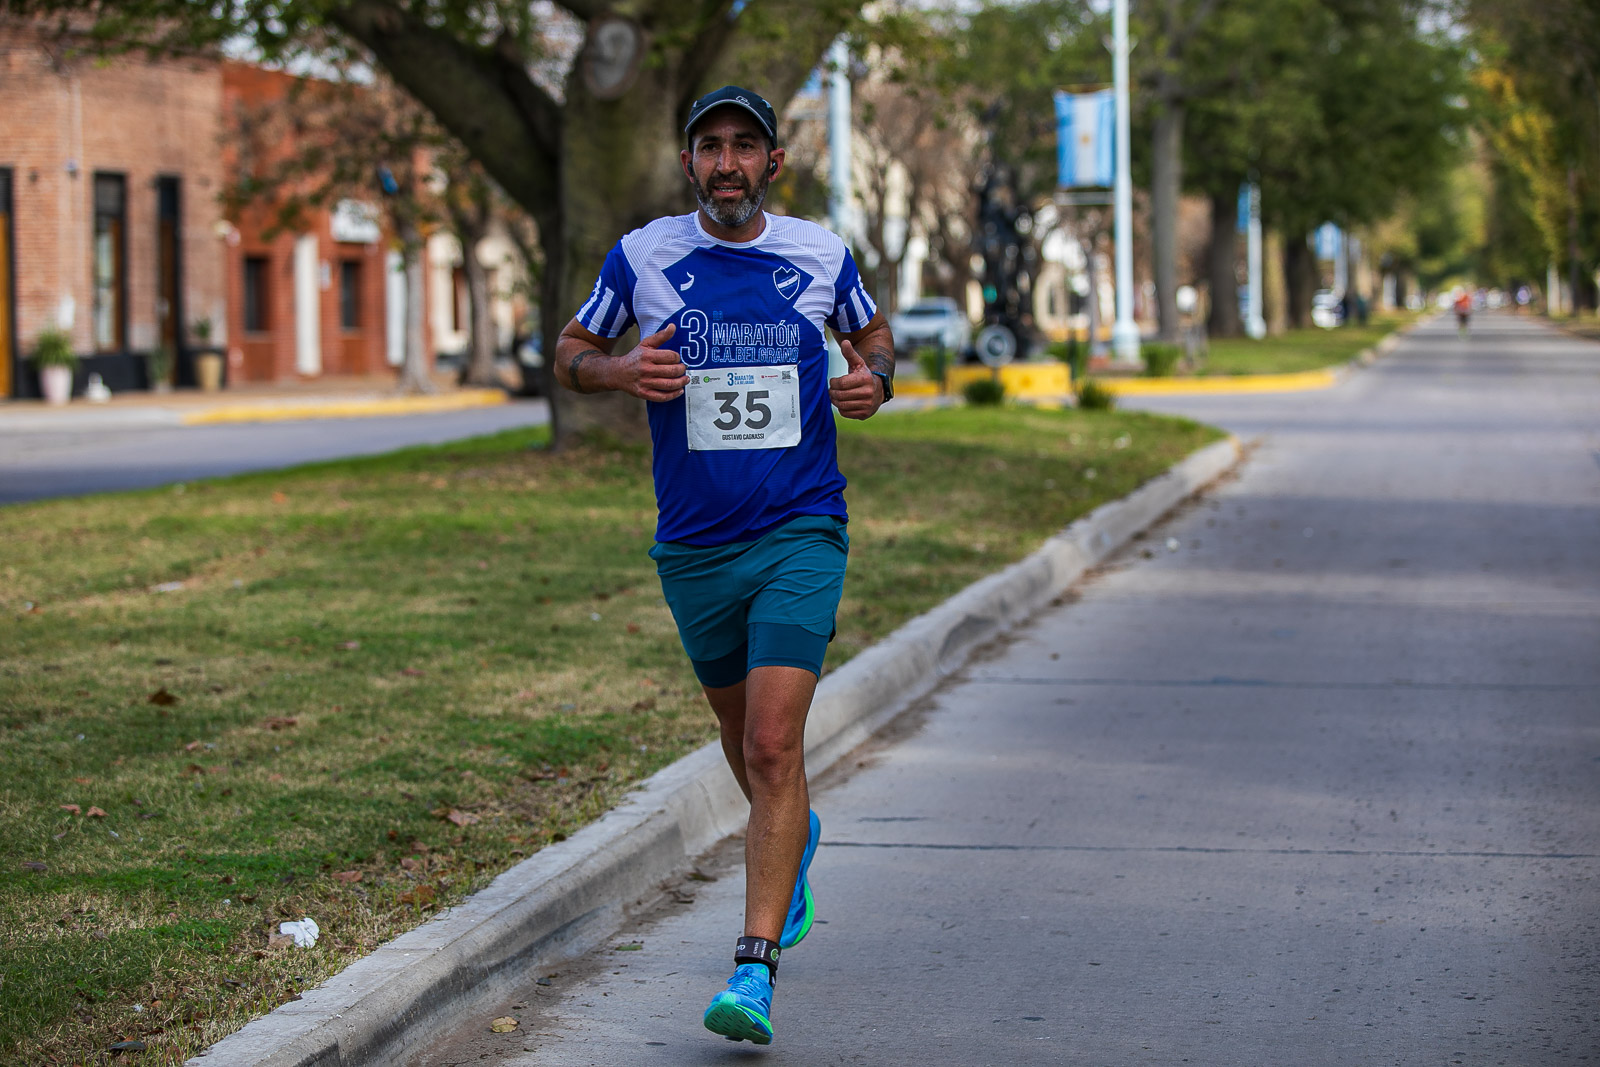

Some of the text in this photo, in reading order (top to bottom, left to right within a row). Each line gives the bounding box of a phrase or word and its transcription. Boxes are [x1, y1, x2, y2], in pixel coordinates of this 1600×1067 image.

[680, 309, 708, 367] 3
[712, 320, 800, 346] MARATÓN
[727, 372, 734, 386] 3
[713, 390, 771, 430] 35
